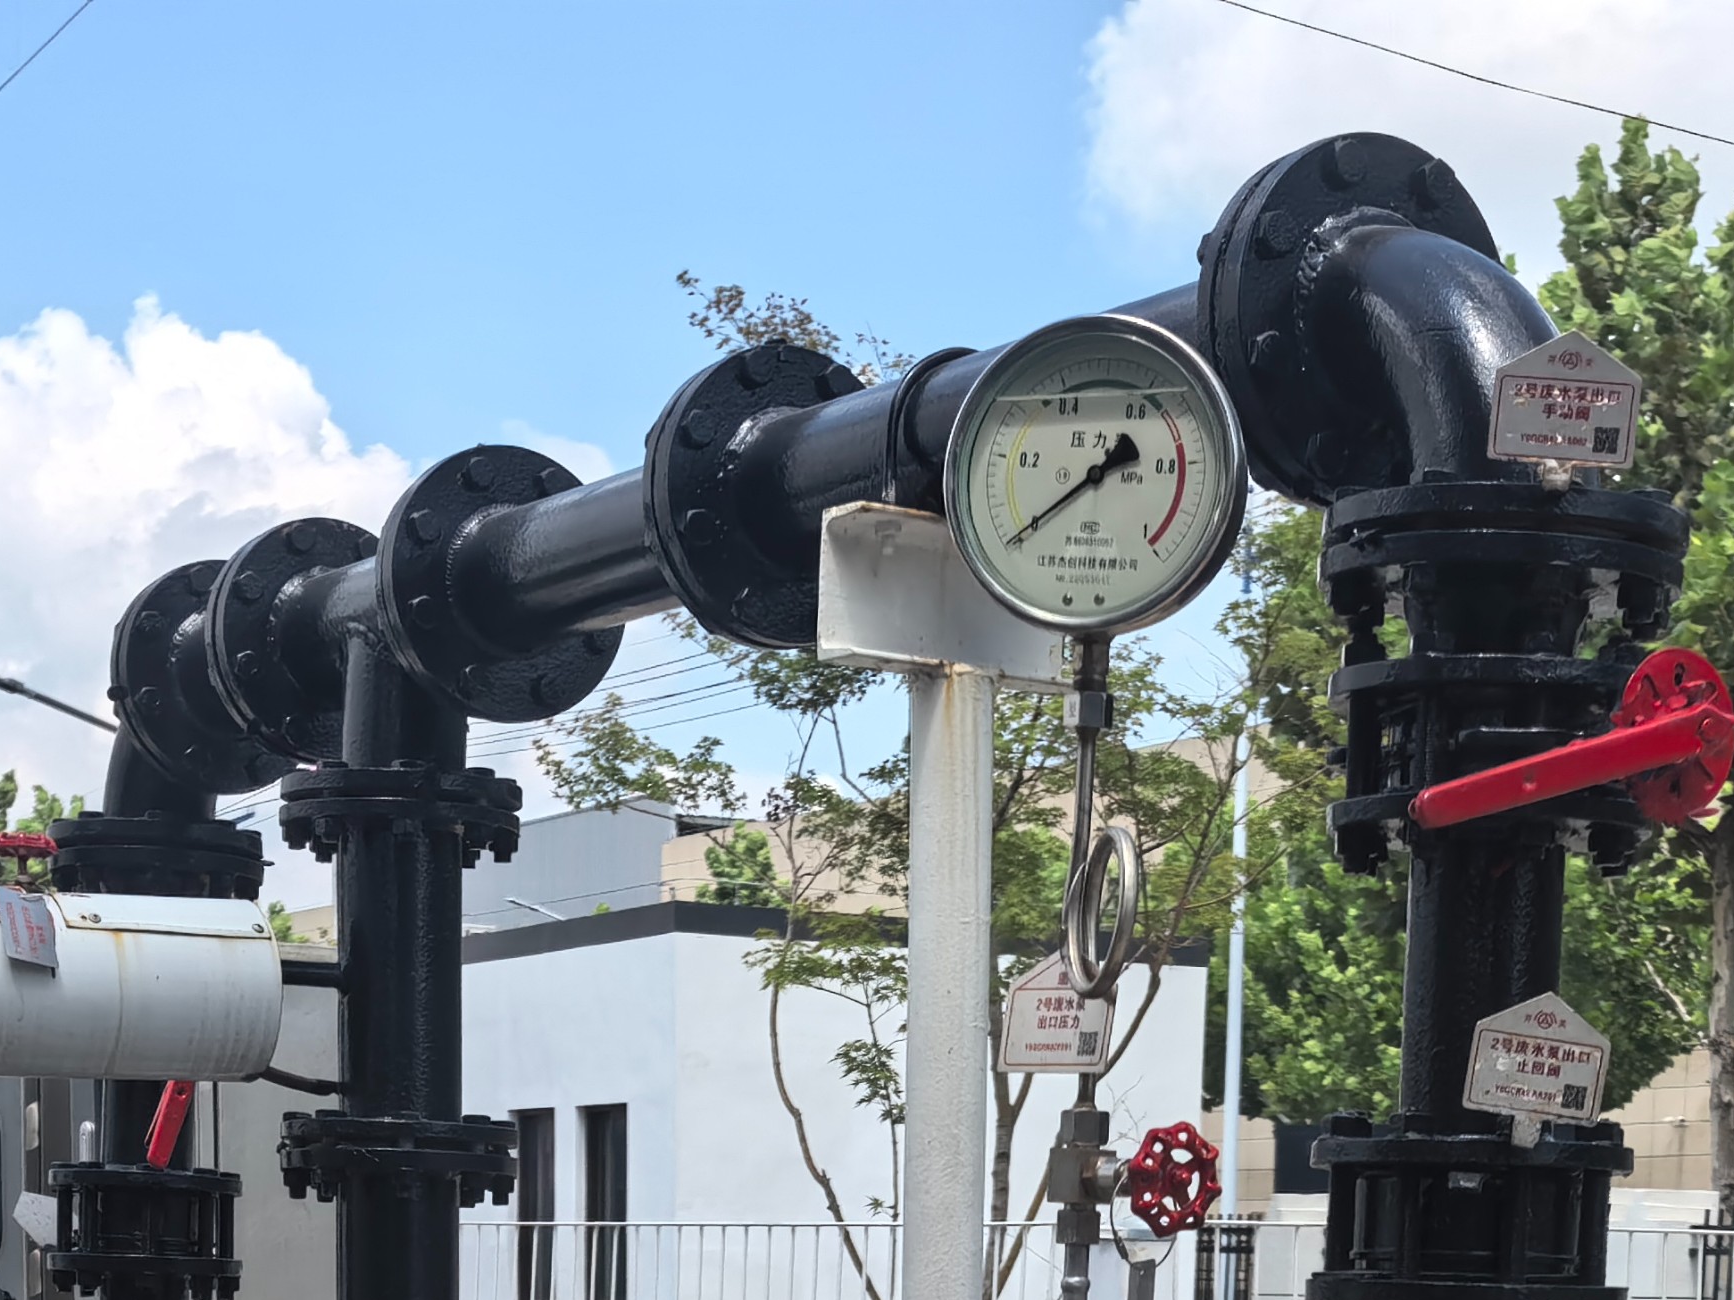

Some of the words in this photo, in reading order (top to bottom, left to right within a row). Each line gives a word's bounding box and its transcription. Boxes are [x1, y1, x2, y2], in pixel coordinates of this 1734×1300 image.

[1058, 397, 1079, 416] 0.4
[1125, 403, 1146, 420] 0.6
[1541, 403, 1591, 421] 手动阀
[1070, 430, 1123, 449] 压力
[1019, 451, 1040, 468] 0.2
[1155, 458, 1176, 475] 0.8
[1120, 471, 1143, 485] MPa
[1143, 523, 1148, 539] 1
[1036, 1014, 1080, 1030] 出口压力
[1490, 1037, 1591, 1065] 2号废水泵出口
[1515, 1060, 1561, 1079] 止回阀
